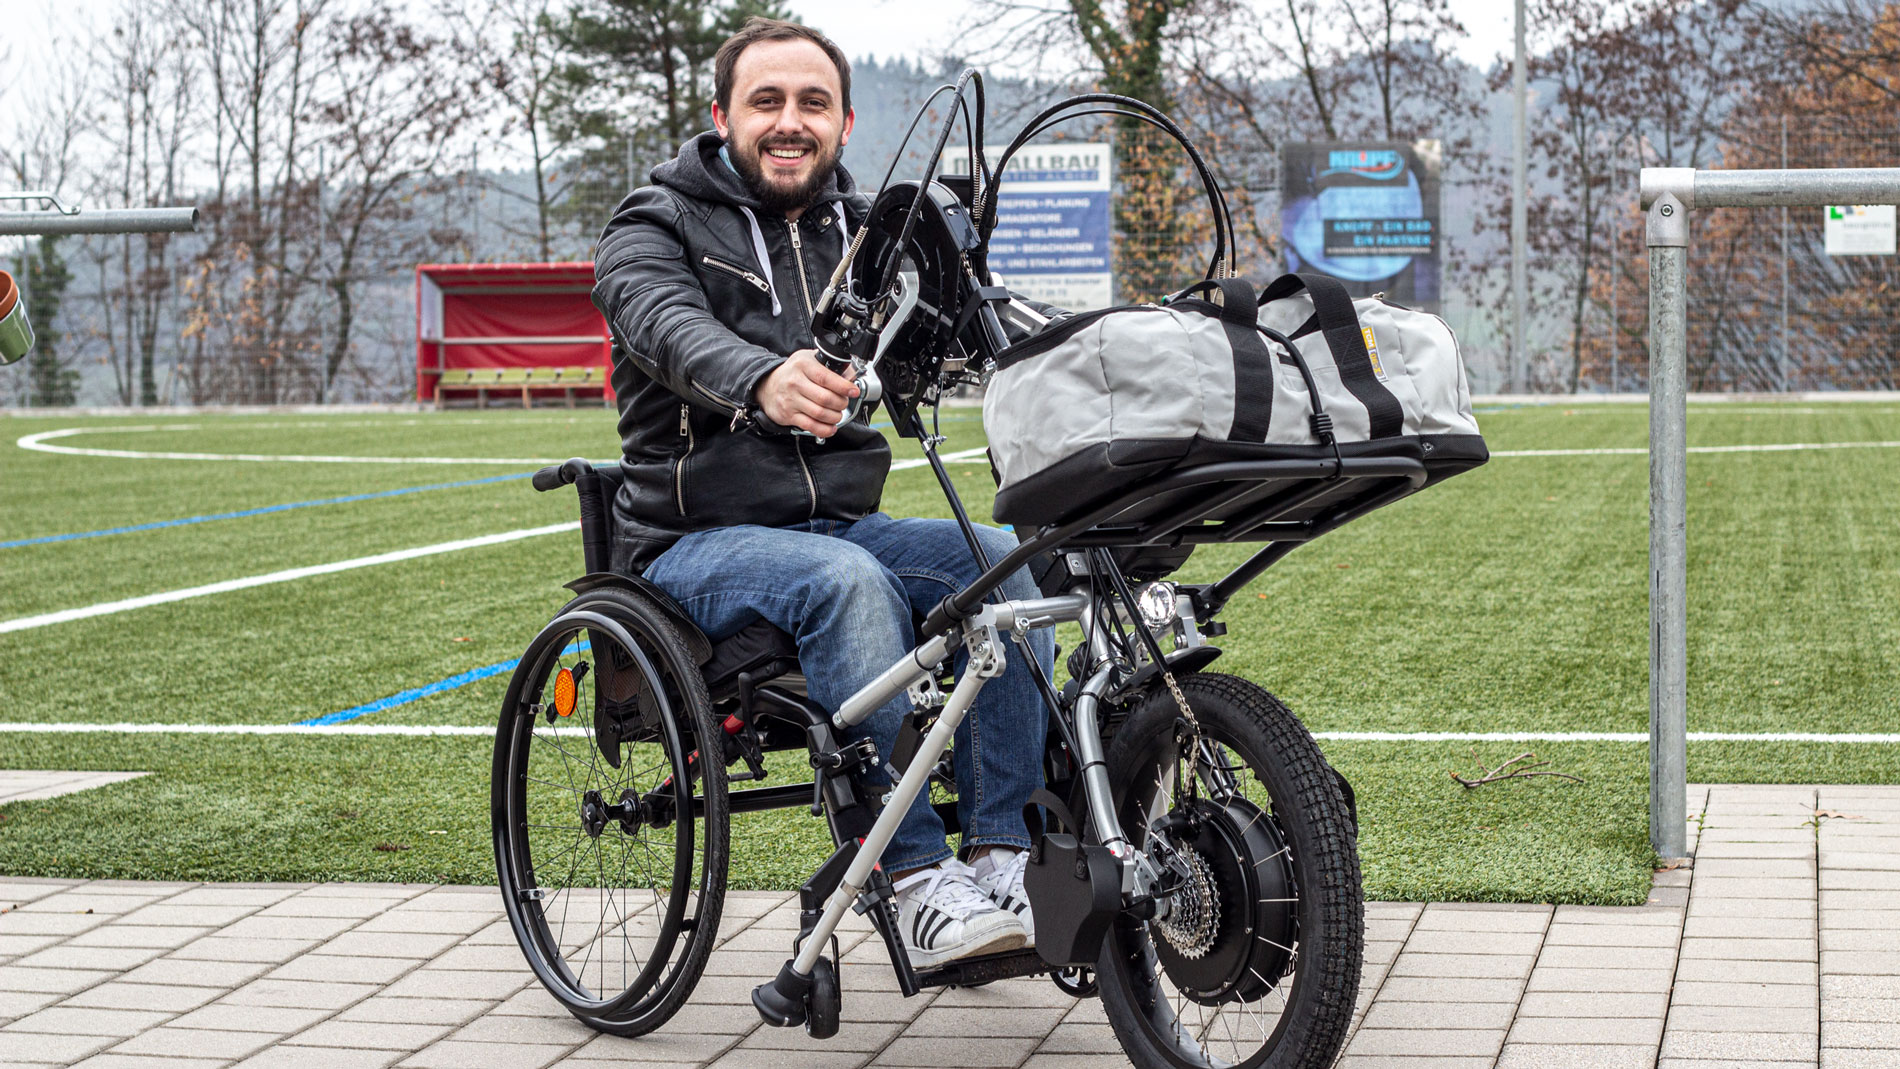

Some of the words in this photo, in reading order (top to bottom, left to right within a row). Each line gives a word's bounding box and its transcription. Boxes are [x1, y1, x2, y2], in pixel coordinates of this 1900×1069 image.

[954, 155, 1100, 174] MTALLBAU
[1045, 197, 1091, 208] PLANUNG
[998, 213, 1062, 224] ARAGENTORE
[1029, 226, 1080, 239] GELÄNDER
[1383, 221, 1404, 232] EIN
[1353, 235, 1375, 246] EIN
[1022, 242, 1094, 254] BEDACHUNGEN
[1007, 259, 1028, 269] UND
[1029, 257, 1105, 268] STAHLARBEITEN
[1364, 329, 1375, 348] TCM
